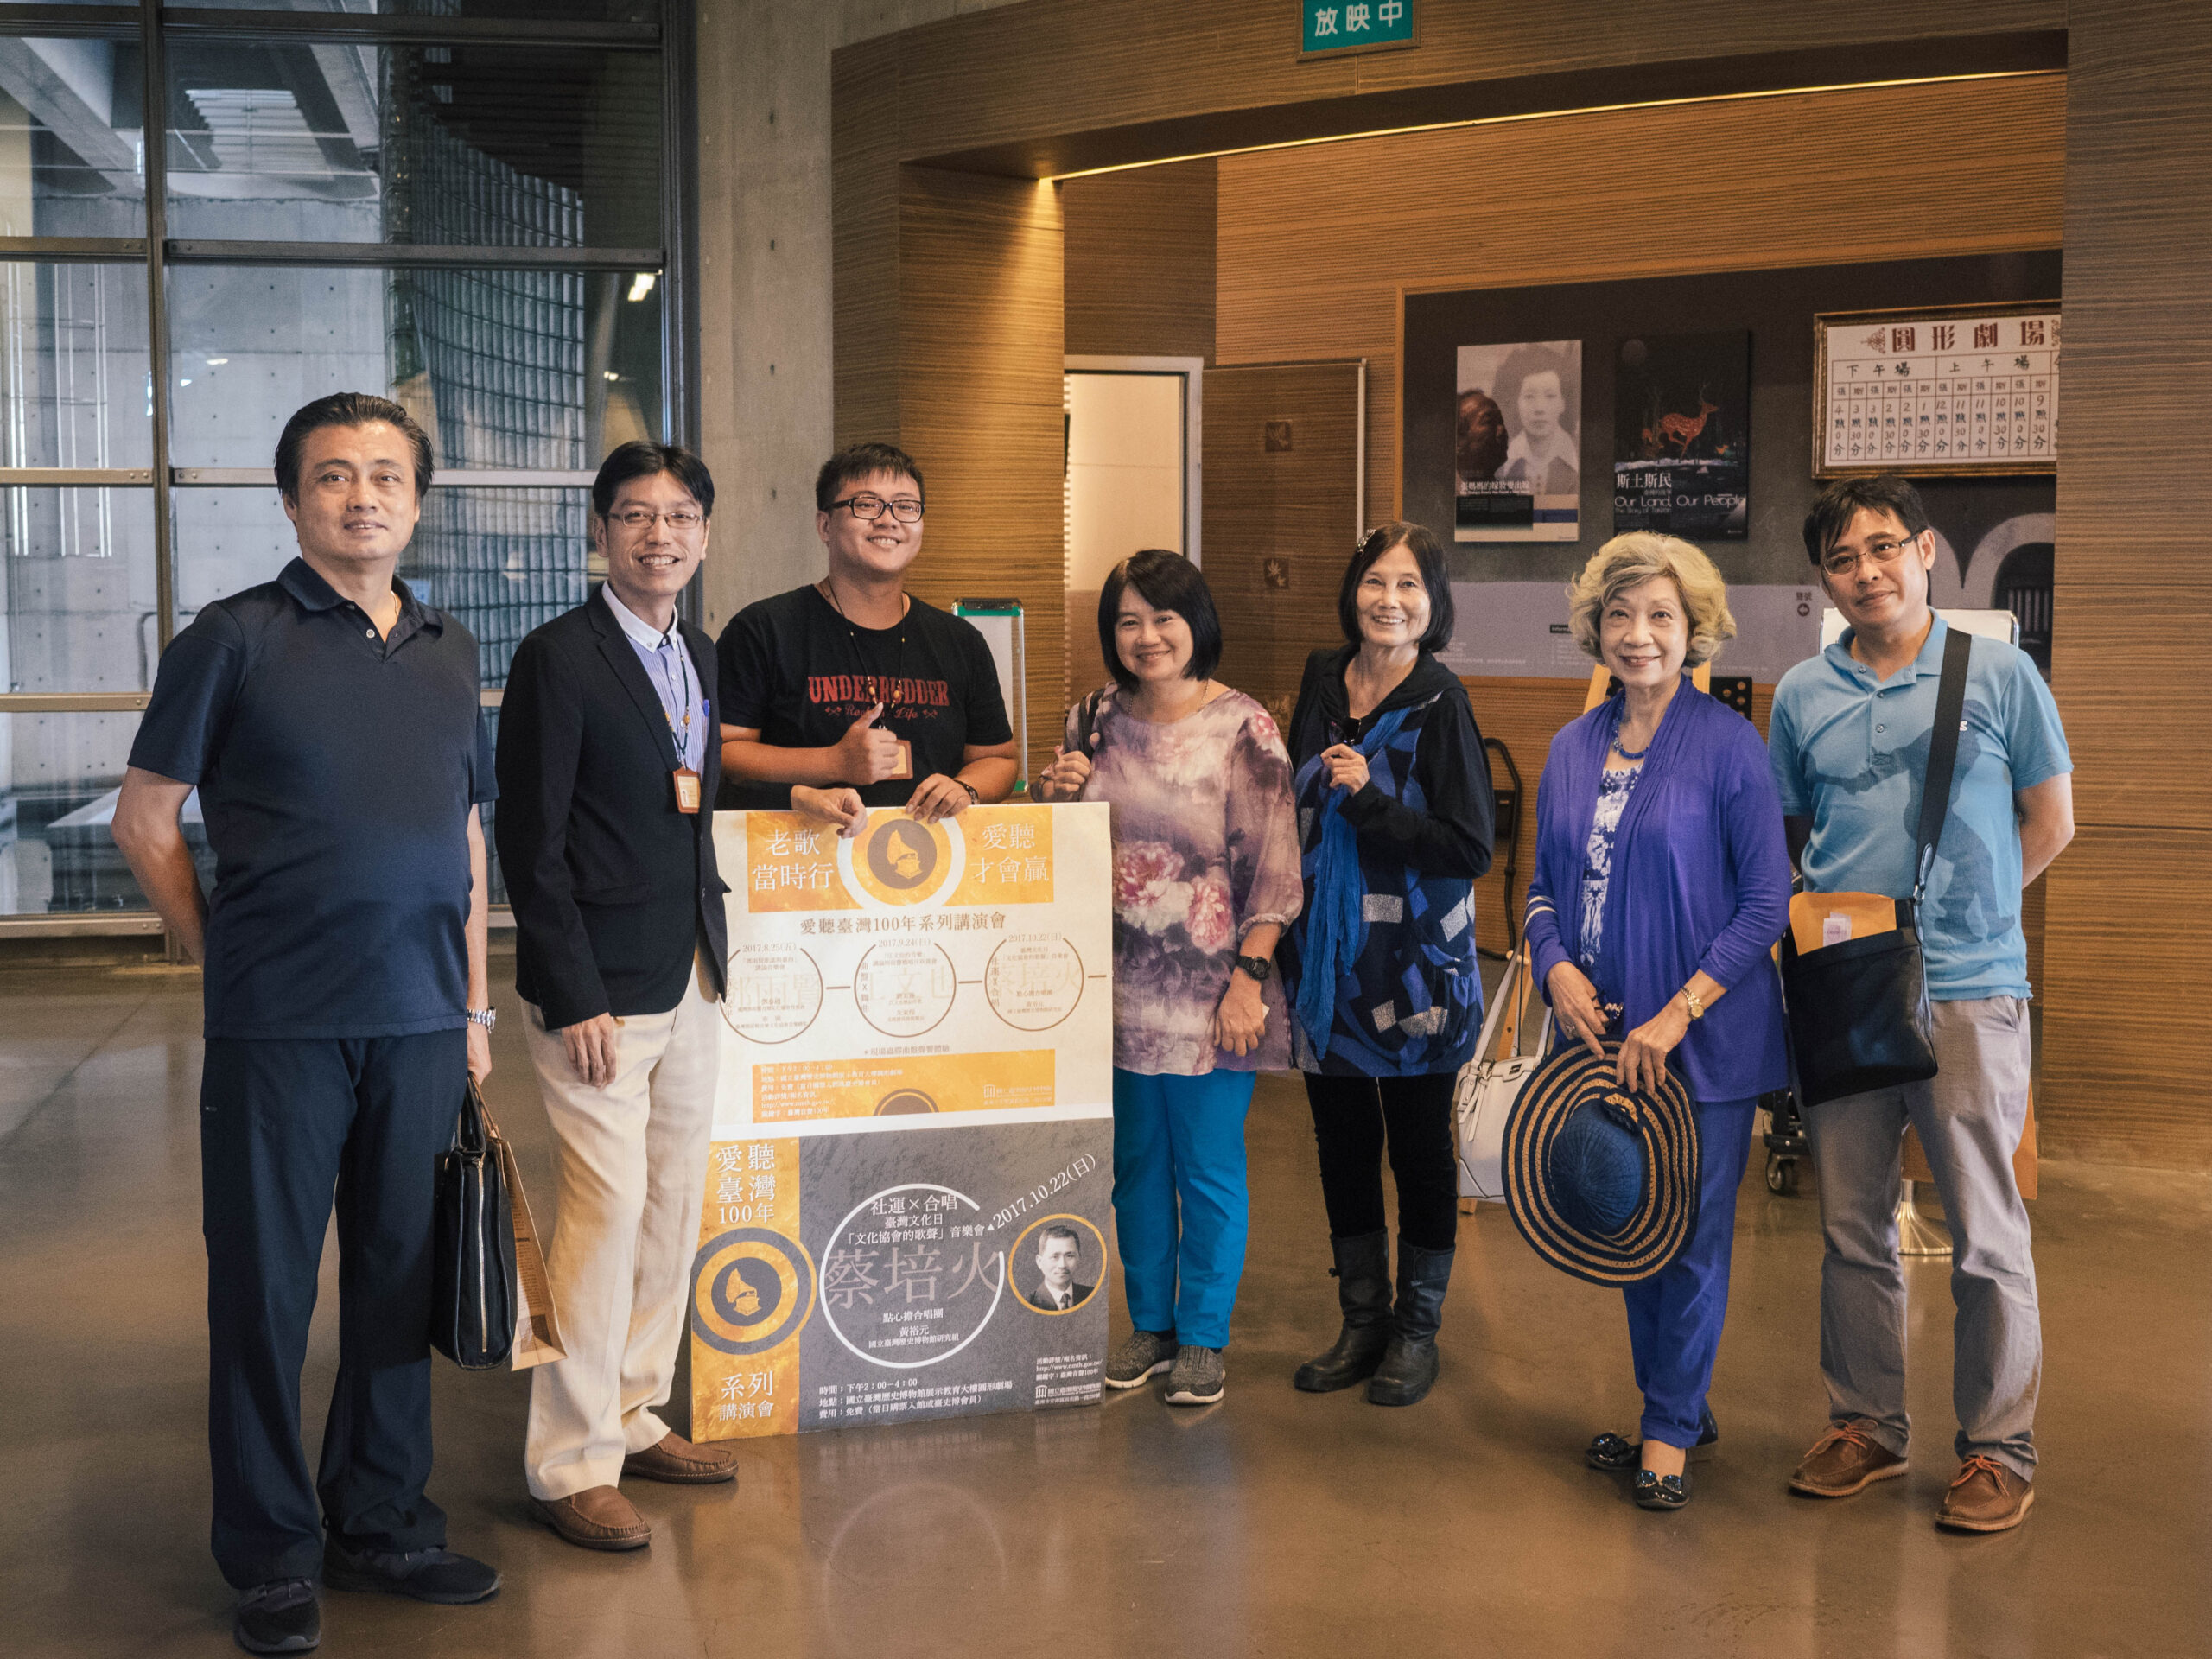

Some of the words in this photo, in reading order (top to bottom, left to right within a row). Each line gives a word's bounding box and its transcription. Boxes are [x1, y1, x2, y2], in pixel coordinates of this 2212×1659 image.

[1314, 0, 1402, 37] 放映中
[1891, 320, 2045, 353] 圓形劇場
[1847, 362, 1910, 378] 下午場
[1949, 355, 2030, 373] 上午場
[1617, 472, 1672, 489] 斯土斯民
[1615, 496, 1636, 507] Our
[1676, 495, 1700, 506] Our
[893, 706, 918, 721] Life
[766, 829, 820, 856] 老歌
[982, 823, 1035, 850] 愛聽
[752, 862, 835, 891] 當時行
[969, 855, 1049, 884] 才會贏
[800, 911, 1006, 936] 愛聽臺灣100年系列講演會
[715, 1143, 775, 1173] 愛聽
[716, 1174, 776, 1204] 臺灣
[993, 1154, 1096, 1229] 2017.10.22(日)
[719, 1202, 775, 1224] 100年
[885, 1213, 943, 1229] 臺灣文化日
[950, 1224, 984, 1238] 音樂會
[824, 1242, 1000, 1309] 蔡培火
[721, 1370, 773, 1401] 系列
[719, 1400, 774, 1421] 講演會
